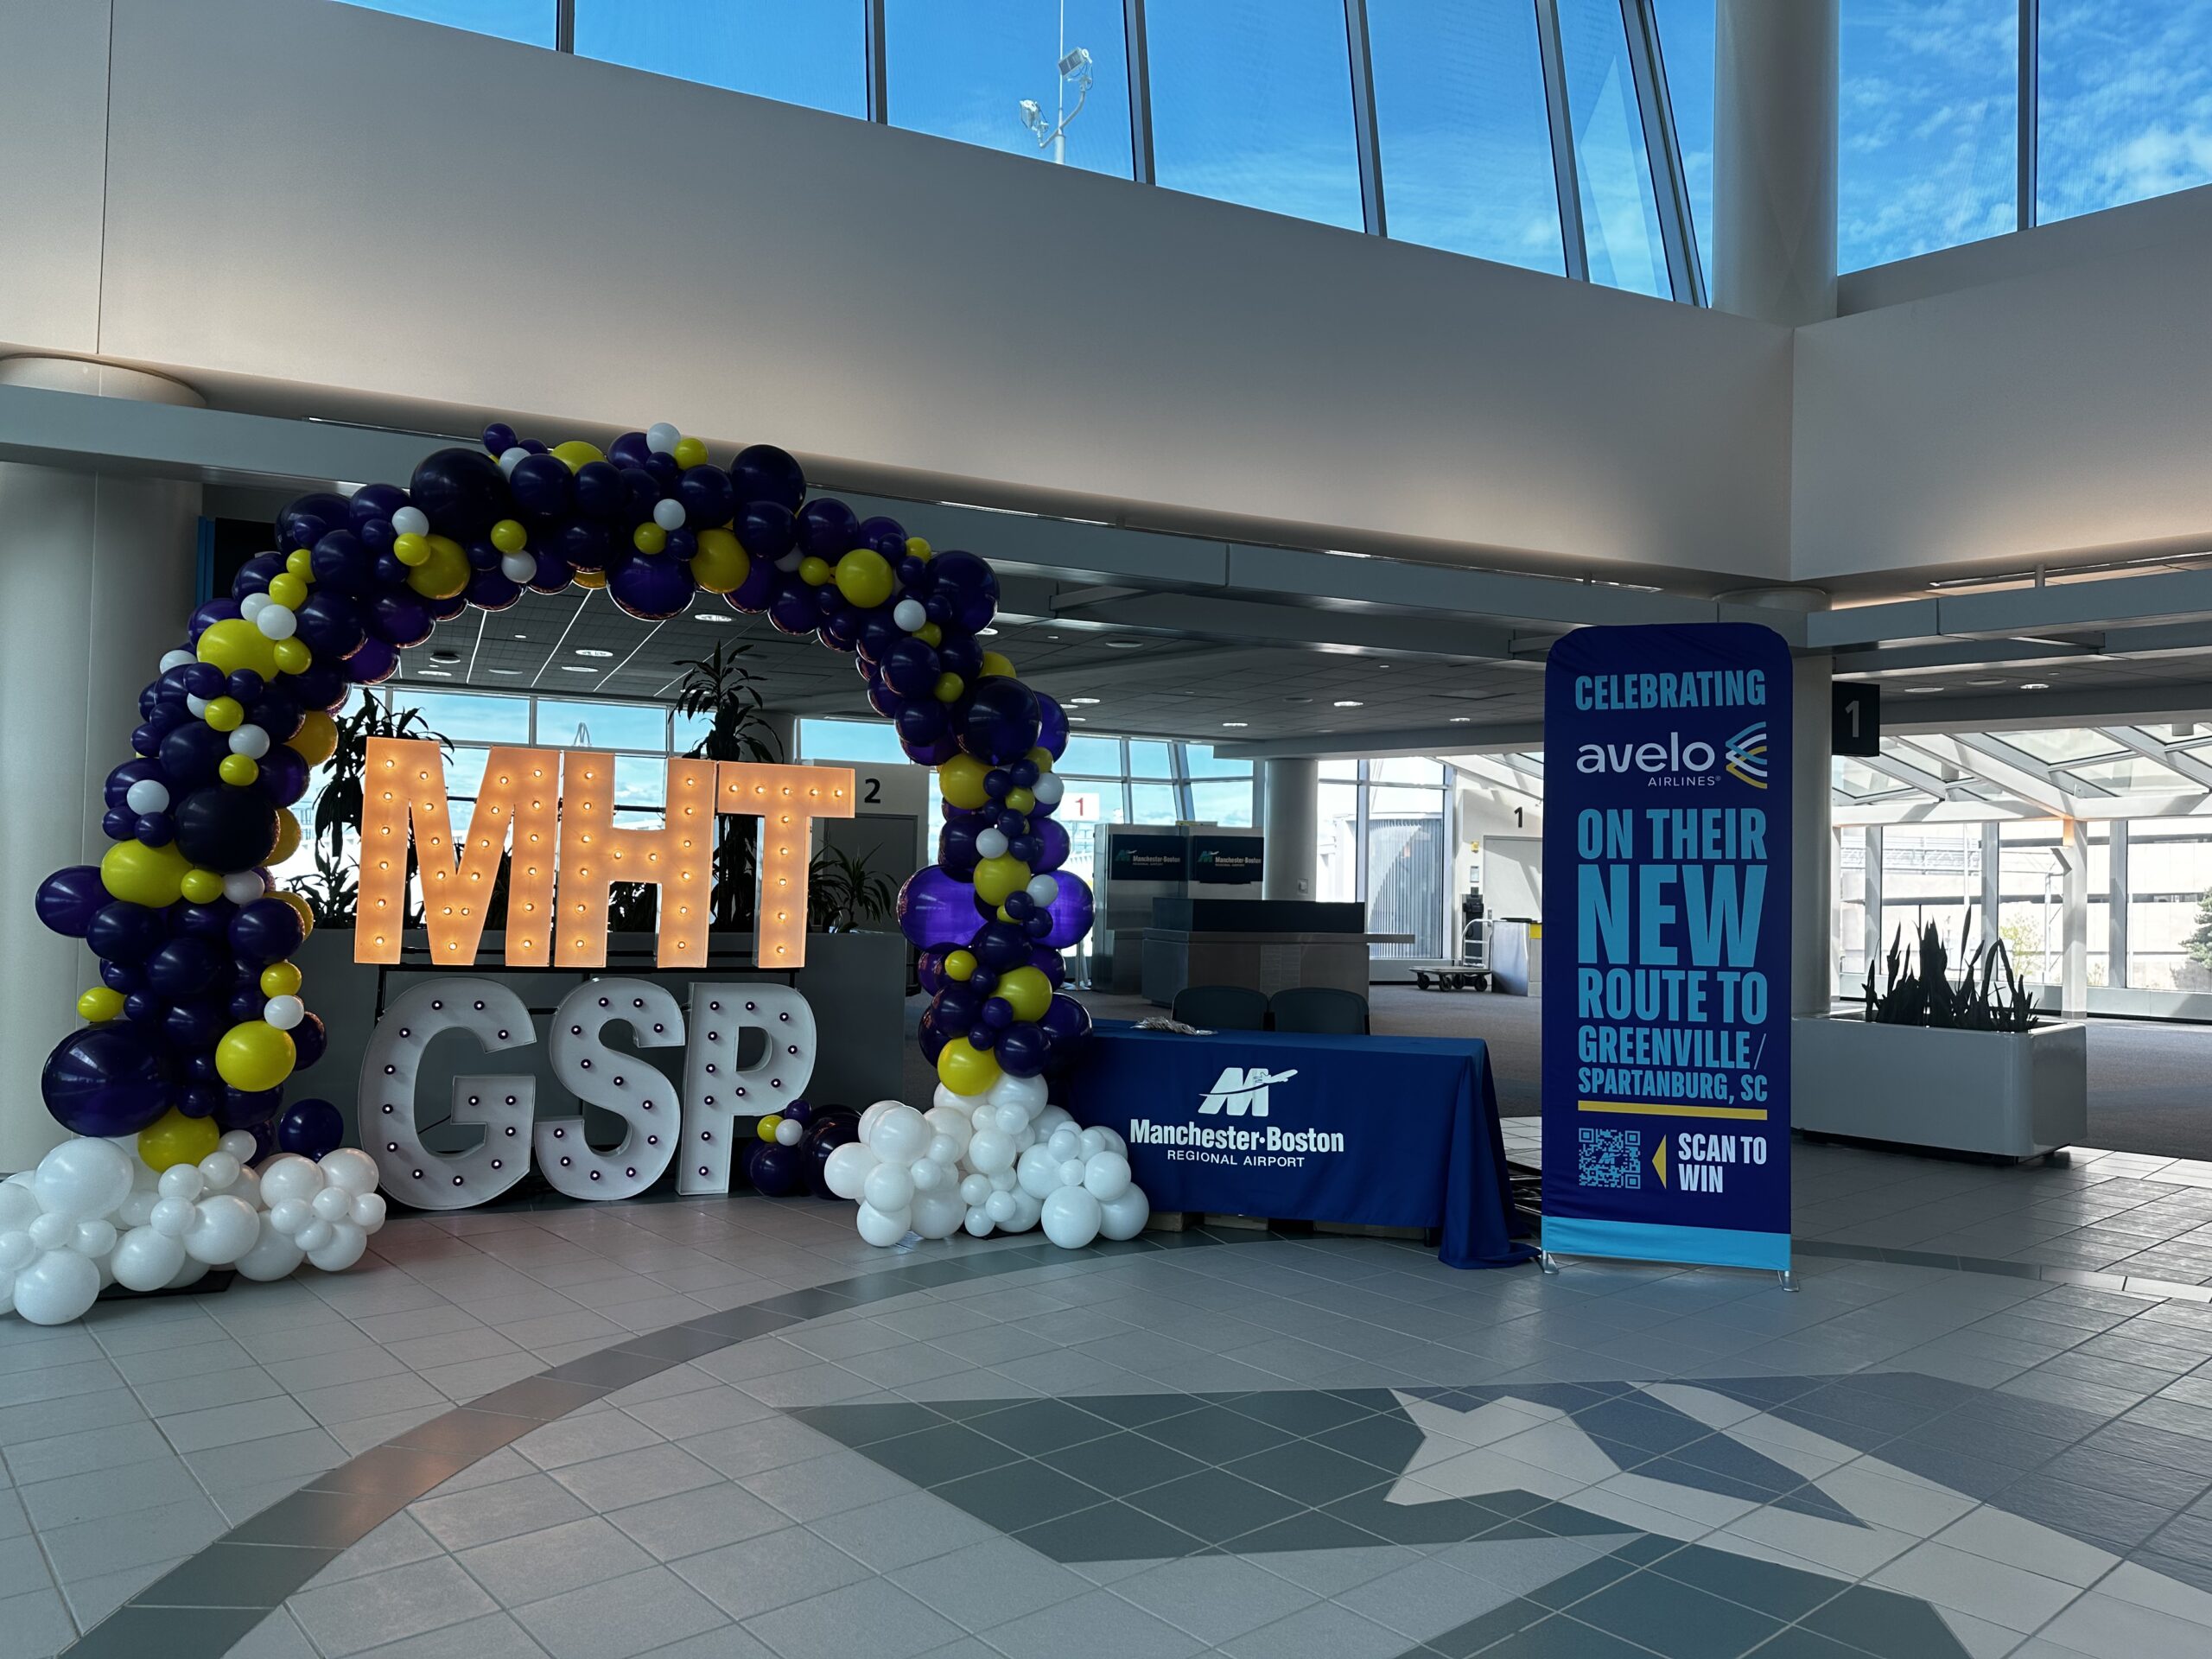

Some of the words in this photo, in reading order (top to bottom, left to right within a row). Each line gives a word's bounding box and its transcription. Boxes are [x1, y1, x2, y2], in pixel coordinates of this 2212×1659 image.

[1575, 670, 1767, 711] CELEBRATING
[1845, 700, 1859, 738] 1
[1576, 732, 1715, 773] avelo
[864, 778, 881, 804] 2
[1075, 797, 1084, 817] 1
[1514, 806, 1523, 828] 1
[1578, 809, 1633, 860] ON
[1646, 809, 1768, 860] THEIR
[354, 736, 855, 969] MHT
[1578, 864, 1768, 967] NEW
[1578, 968, 1707, 1021] ROUTE
[1717, 971, 1768, 1025] TO
[358, 976, 817, 1211] GSP
[1578, 1067, 1735, 1104] SPARTANBURG,
[1740, 1074, 1768, 1102] SC
[1167, 1150, 1238, 1166] REGIONAL
[1243, 1155, 1305, 1168] AIRPORT
[1678, 1133, 1736, 1163] SCAN
[1740, 1136, 1768, 1165] TO
[1678, 1163, 1724, 1192] WIN
